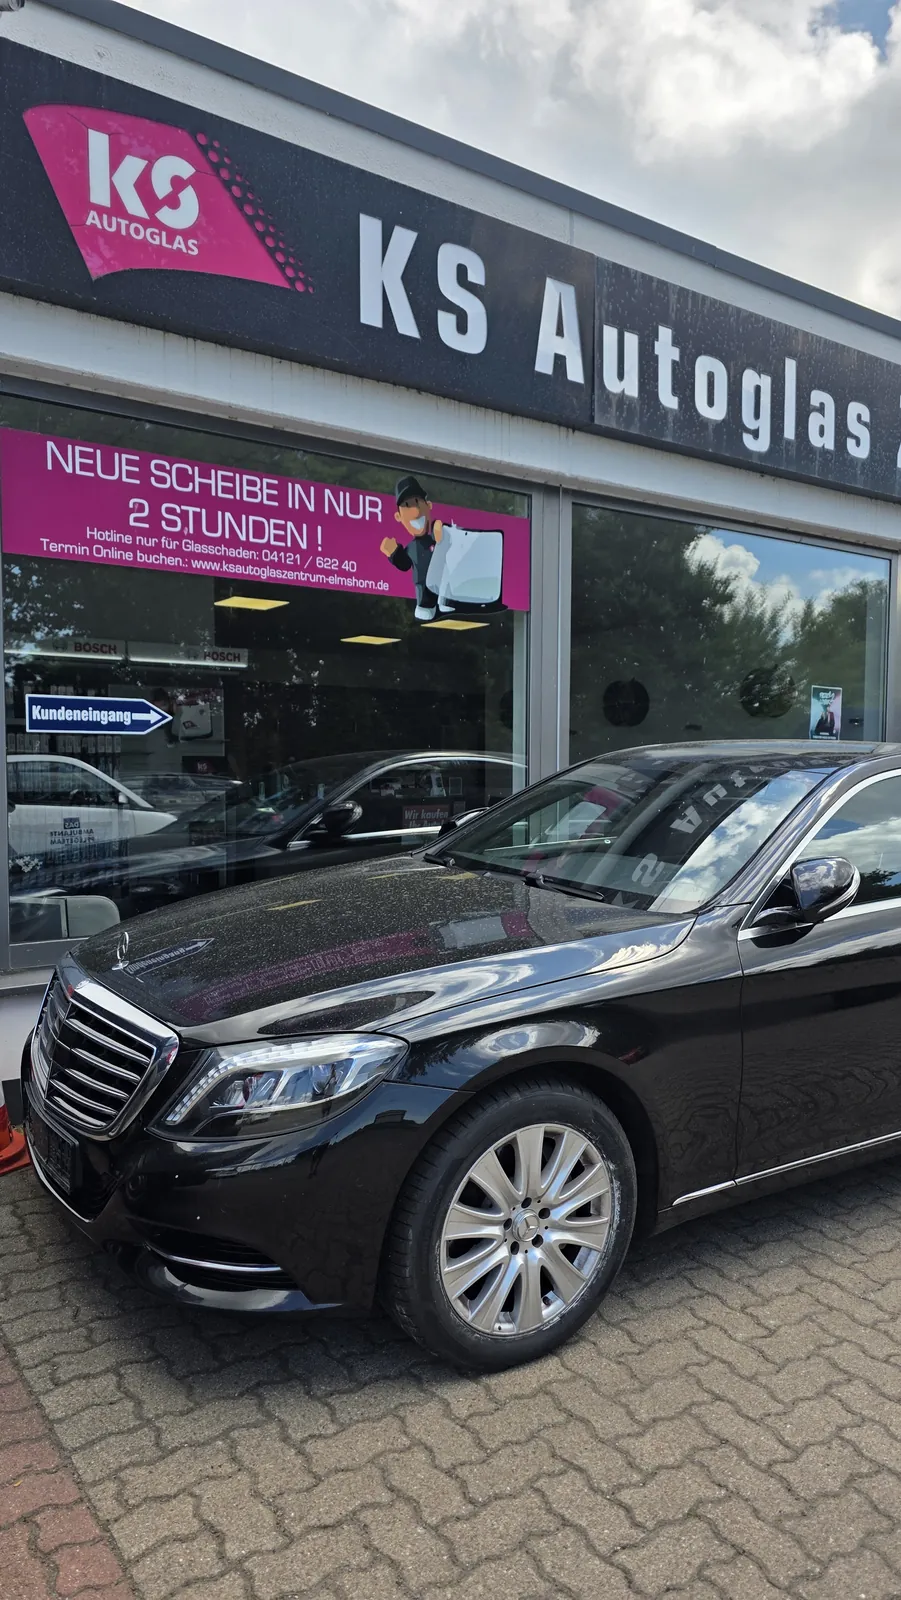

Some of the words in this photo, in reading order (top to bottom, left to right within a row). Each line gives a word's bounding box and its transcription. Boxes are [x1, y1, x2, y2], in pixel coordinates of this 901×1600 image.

[85, 210, 199, 256] AUTOGLAS
[359, 212, 488, 354] KS
[534, 276, 871, 460] Autoglas
[46, 440, 141, 485] NEUE
[150, 459, 279, 507] SCHEIBE
[288, 481, 315, 513] IN
[324, 488, 382, 523] NUR
[129, 498, 150, 529] 2
[161, 502, 307, 550] STUNDEN
[40, 537, 89, 556] Termin
[93, 545, 134, 562] Online
[137, 552, 189, 568] buchen.:
[191, 559, 389, 591] www.ksautoglaszentrum-elmshorn.de
[86, 526, 133, 544] Hotline
[136, 535, 158, 548] nur
[161, 535, 180, 550] für
[182, 539, 259, 561] Glasschaden:
[262, 549, 301, 566] 04121
[304, 555, 313, 569] /
[316, 556, 339, 571] 622
[341, 560, 357, 573] 40
[74, 641, 118, 655] BOSCH
[31, 704, 132, 726] Kundeneingang
[404, 809, 419, 820] Wir
[420, 808, 449, 820] kaufen
